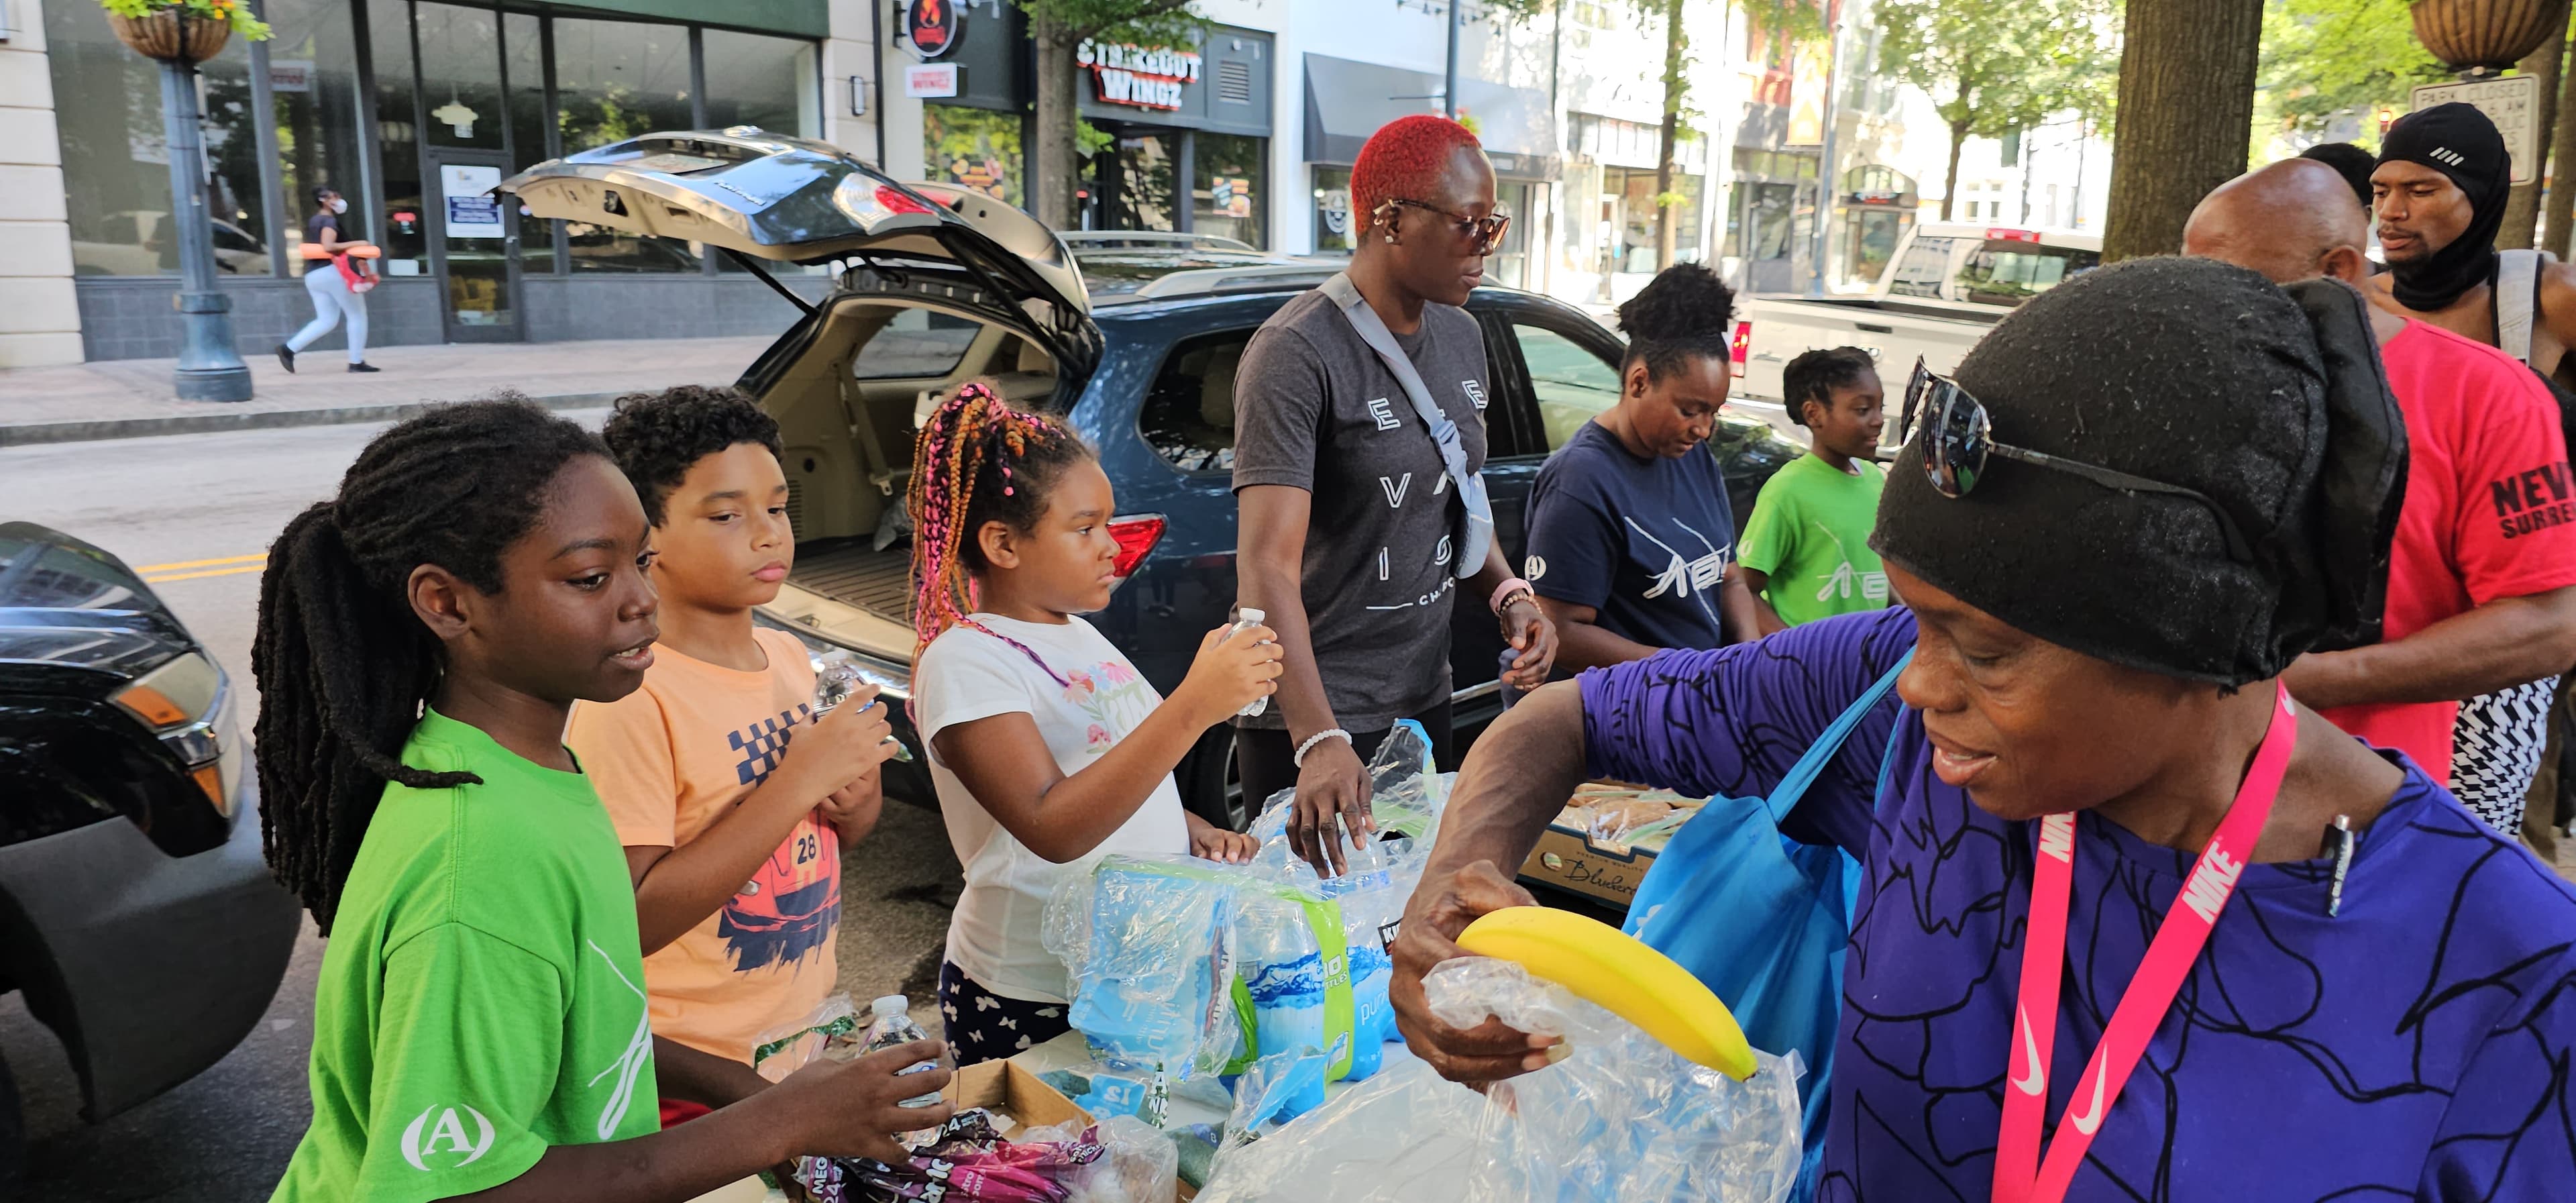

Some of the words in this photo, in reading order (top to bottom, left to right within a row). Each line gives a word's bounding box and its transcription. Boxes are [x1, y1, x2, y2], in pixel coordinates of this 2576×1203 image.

[1100, 68, 1183, 108] WINGZ
[2467, 82, 2529, 102] CLOSED
[2490, 461, 2572, 518] NEV
[2500, 501, 2576, 539] SURRE
[797, 833, 816, 865] 28
[2039, 811, 2075, 864] NIK
[2182, 840, 2243, 925] NIKE
[812, 1157, 828, 1194] MEG
